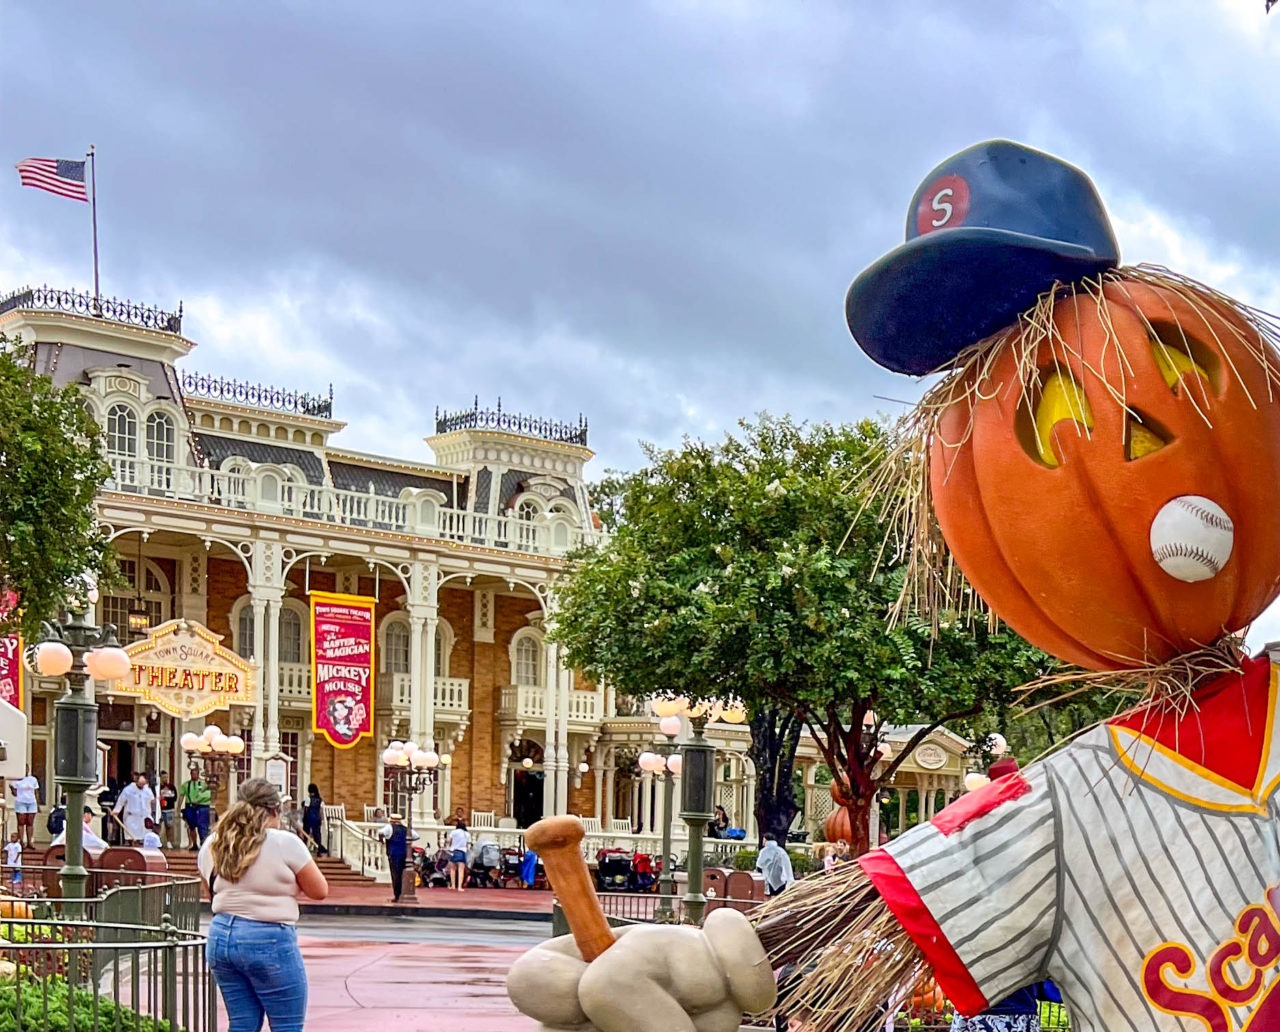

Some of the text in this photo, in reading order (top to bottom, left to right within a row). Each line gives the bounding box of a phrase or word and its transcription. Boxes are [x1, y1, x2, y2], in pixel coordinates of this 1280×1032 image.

[931, 187, 955, 228] S
[154, 644, 216, 665] TOWN SQUARE
[326, 644, 370, 658] MAGICIAN
[130, 664, 239, 693] THEATER
[316, 664, 370, 687] MICKEY
[324, 681, 362, 695] MOUSE
